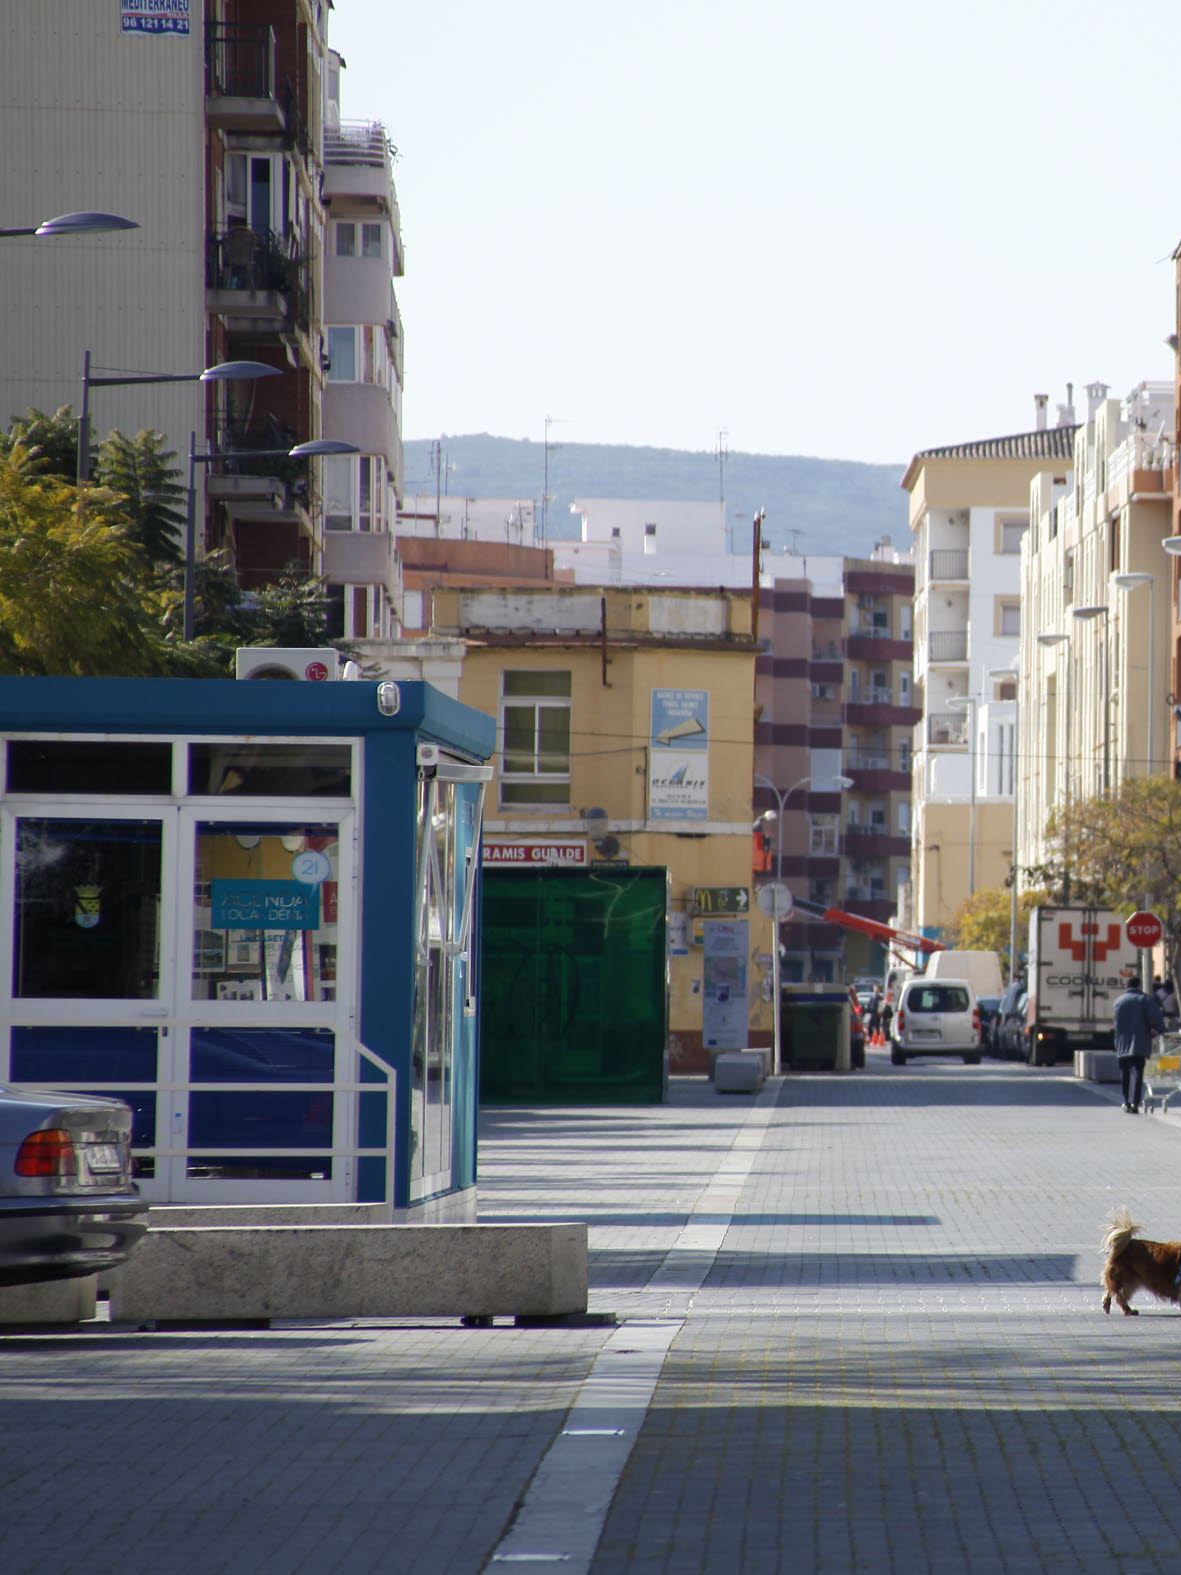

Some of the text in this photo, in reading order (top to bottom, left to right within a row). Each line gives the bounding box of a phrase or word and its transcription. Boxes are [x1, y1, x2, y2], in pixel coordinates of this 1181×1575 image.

[123, 17, 189, 31] 96 121 14 21
[484, 847, 525, 860] RAMIS
[301, 860, 318, 875] 21
[1128, 925, 1160, 935] STOP
[1046, 975, 1130, 988] cooway
